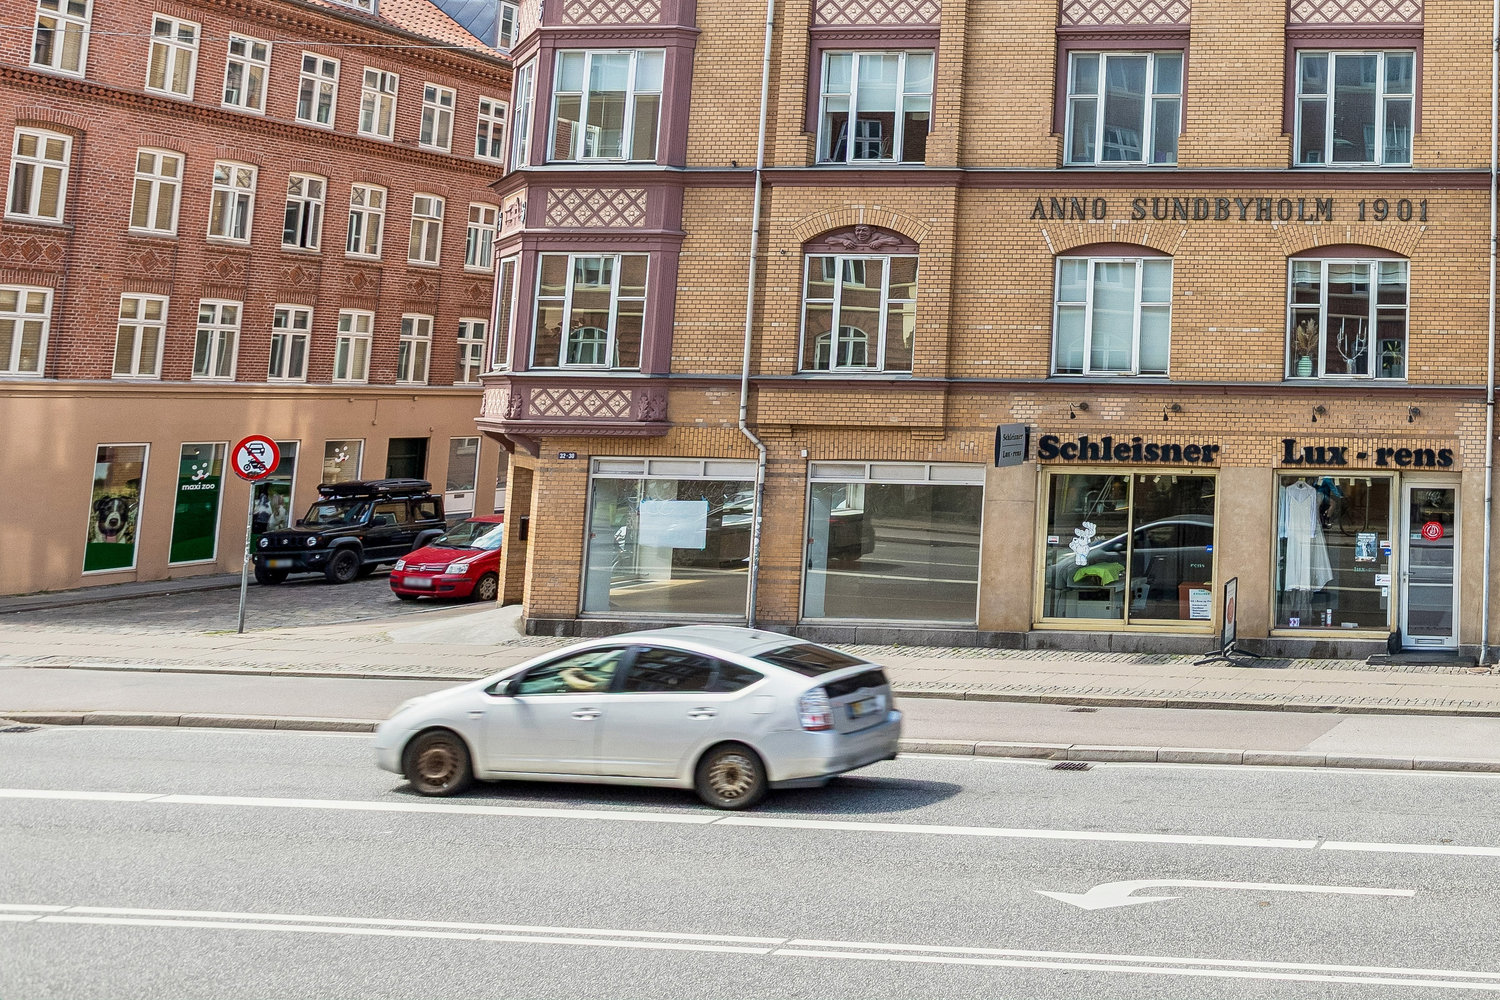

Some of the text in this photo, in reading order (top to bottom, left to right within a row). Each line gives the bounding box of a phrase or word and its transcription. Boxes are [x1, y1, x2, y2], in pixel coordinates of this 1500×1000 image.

[1030, 197, 1429, 222] ANNO SUNDBYHOLM 1901
[1002, 433, 1023, 441] Schleisner
[1037, 434, 1220, 463] Schleisner
[181, 482, 201, 491] maxi
